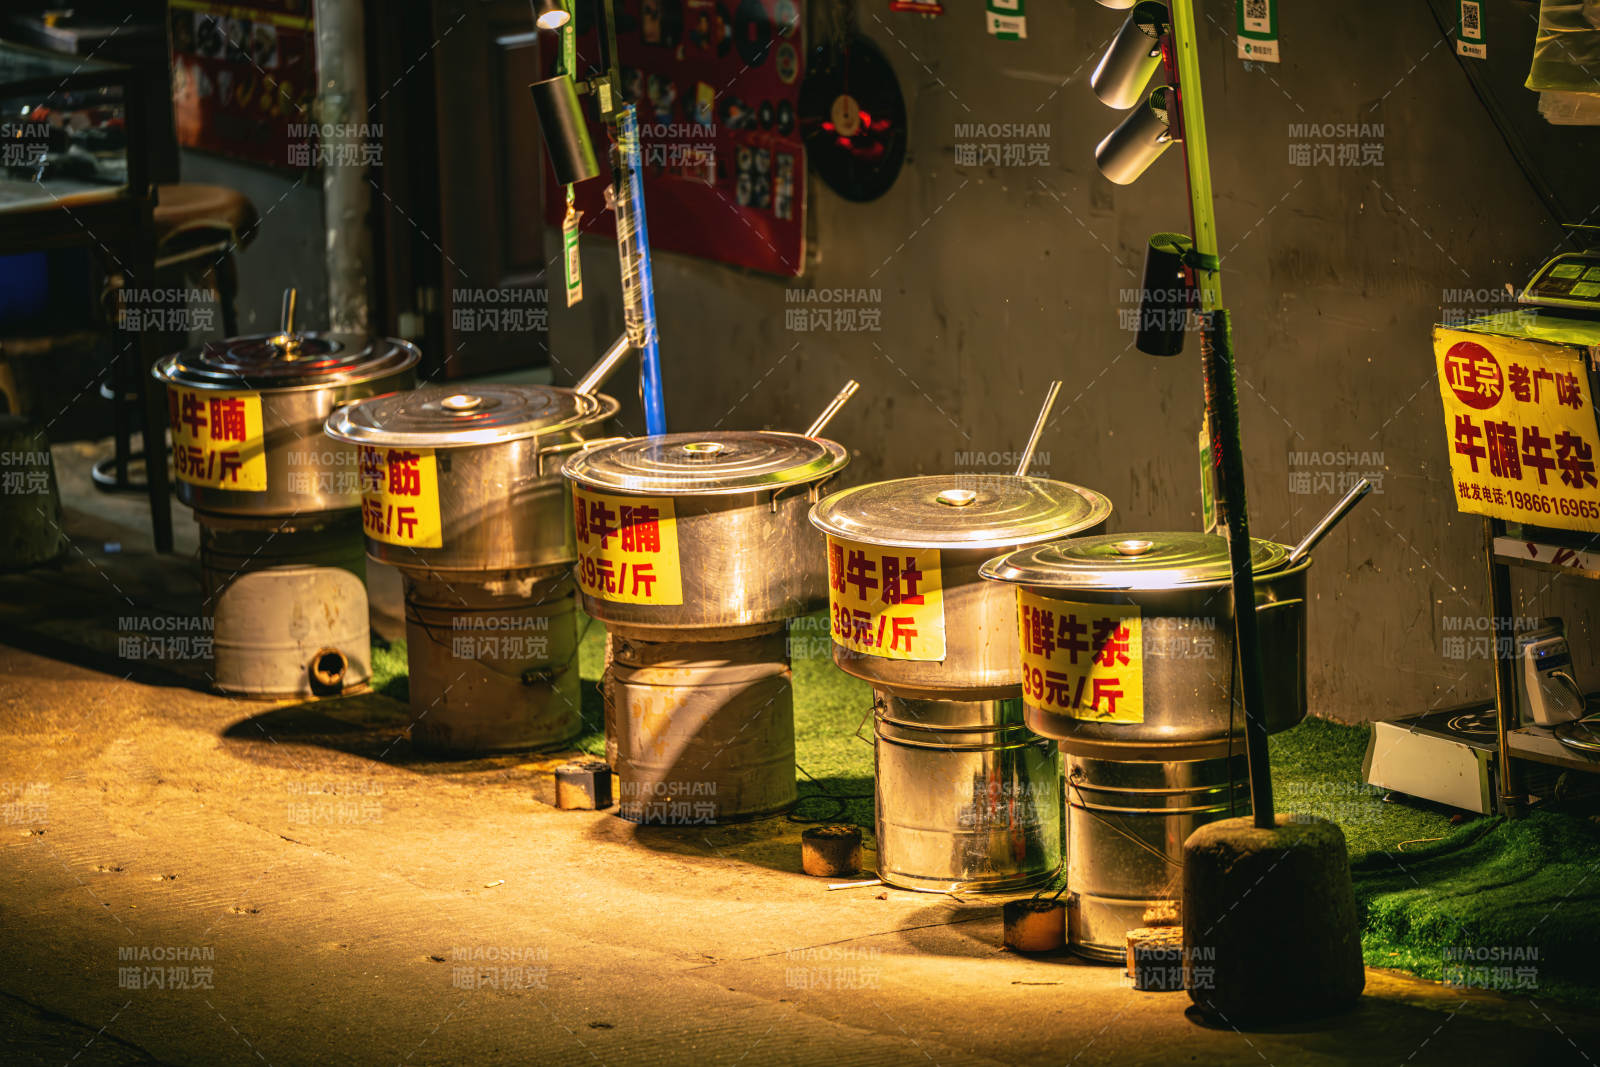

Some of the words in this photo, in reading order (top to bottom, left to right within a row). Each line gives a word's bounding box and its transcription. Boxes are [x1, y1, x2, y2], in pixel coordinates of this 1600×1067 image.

[1448, 356, 1500, 398] 正宗
[1507, 362, 1584, 410] 老广味
[358, 445, 421, 496] 牛筋
[1454, 414, 1599, 489] 牛腩牛杂
[1458, 480, 1600, 519] 批发电话:1986616965
[579, 553, 657, 597] 39元/斤
[832, 601, 918, 653] 39元/斤
[1023, 662, 1124, 714] 39元/斤
